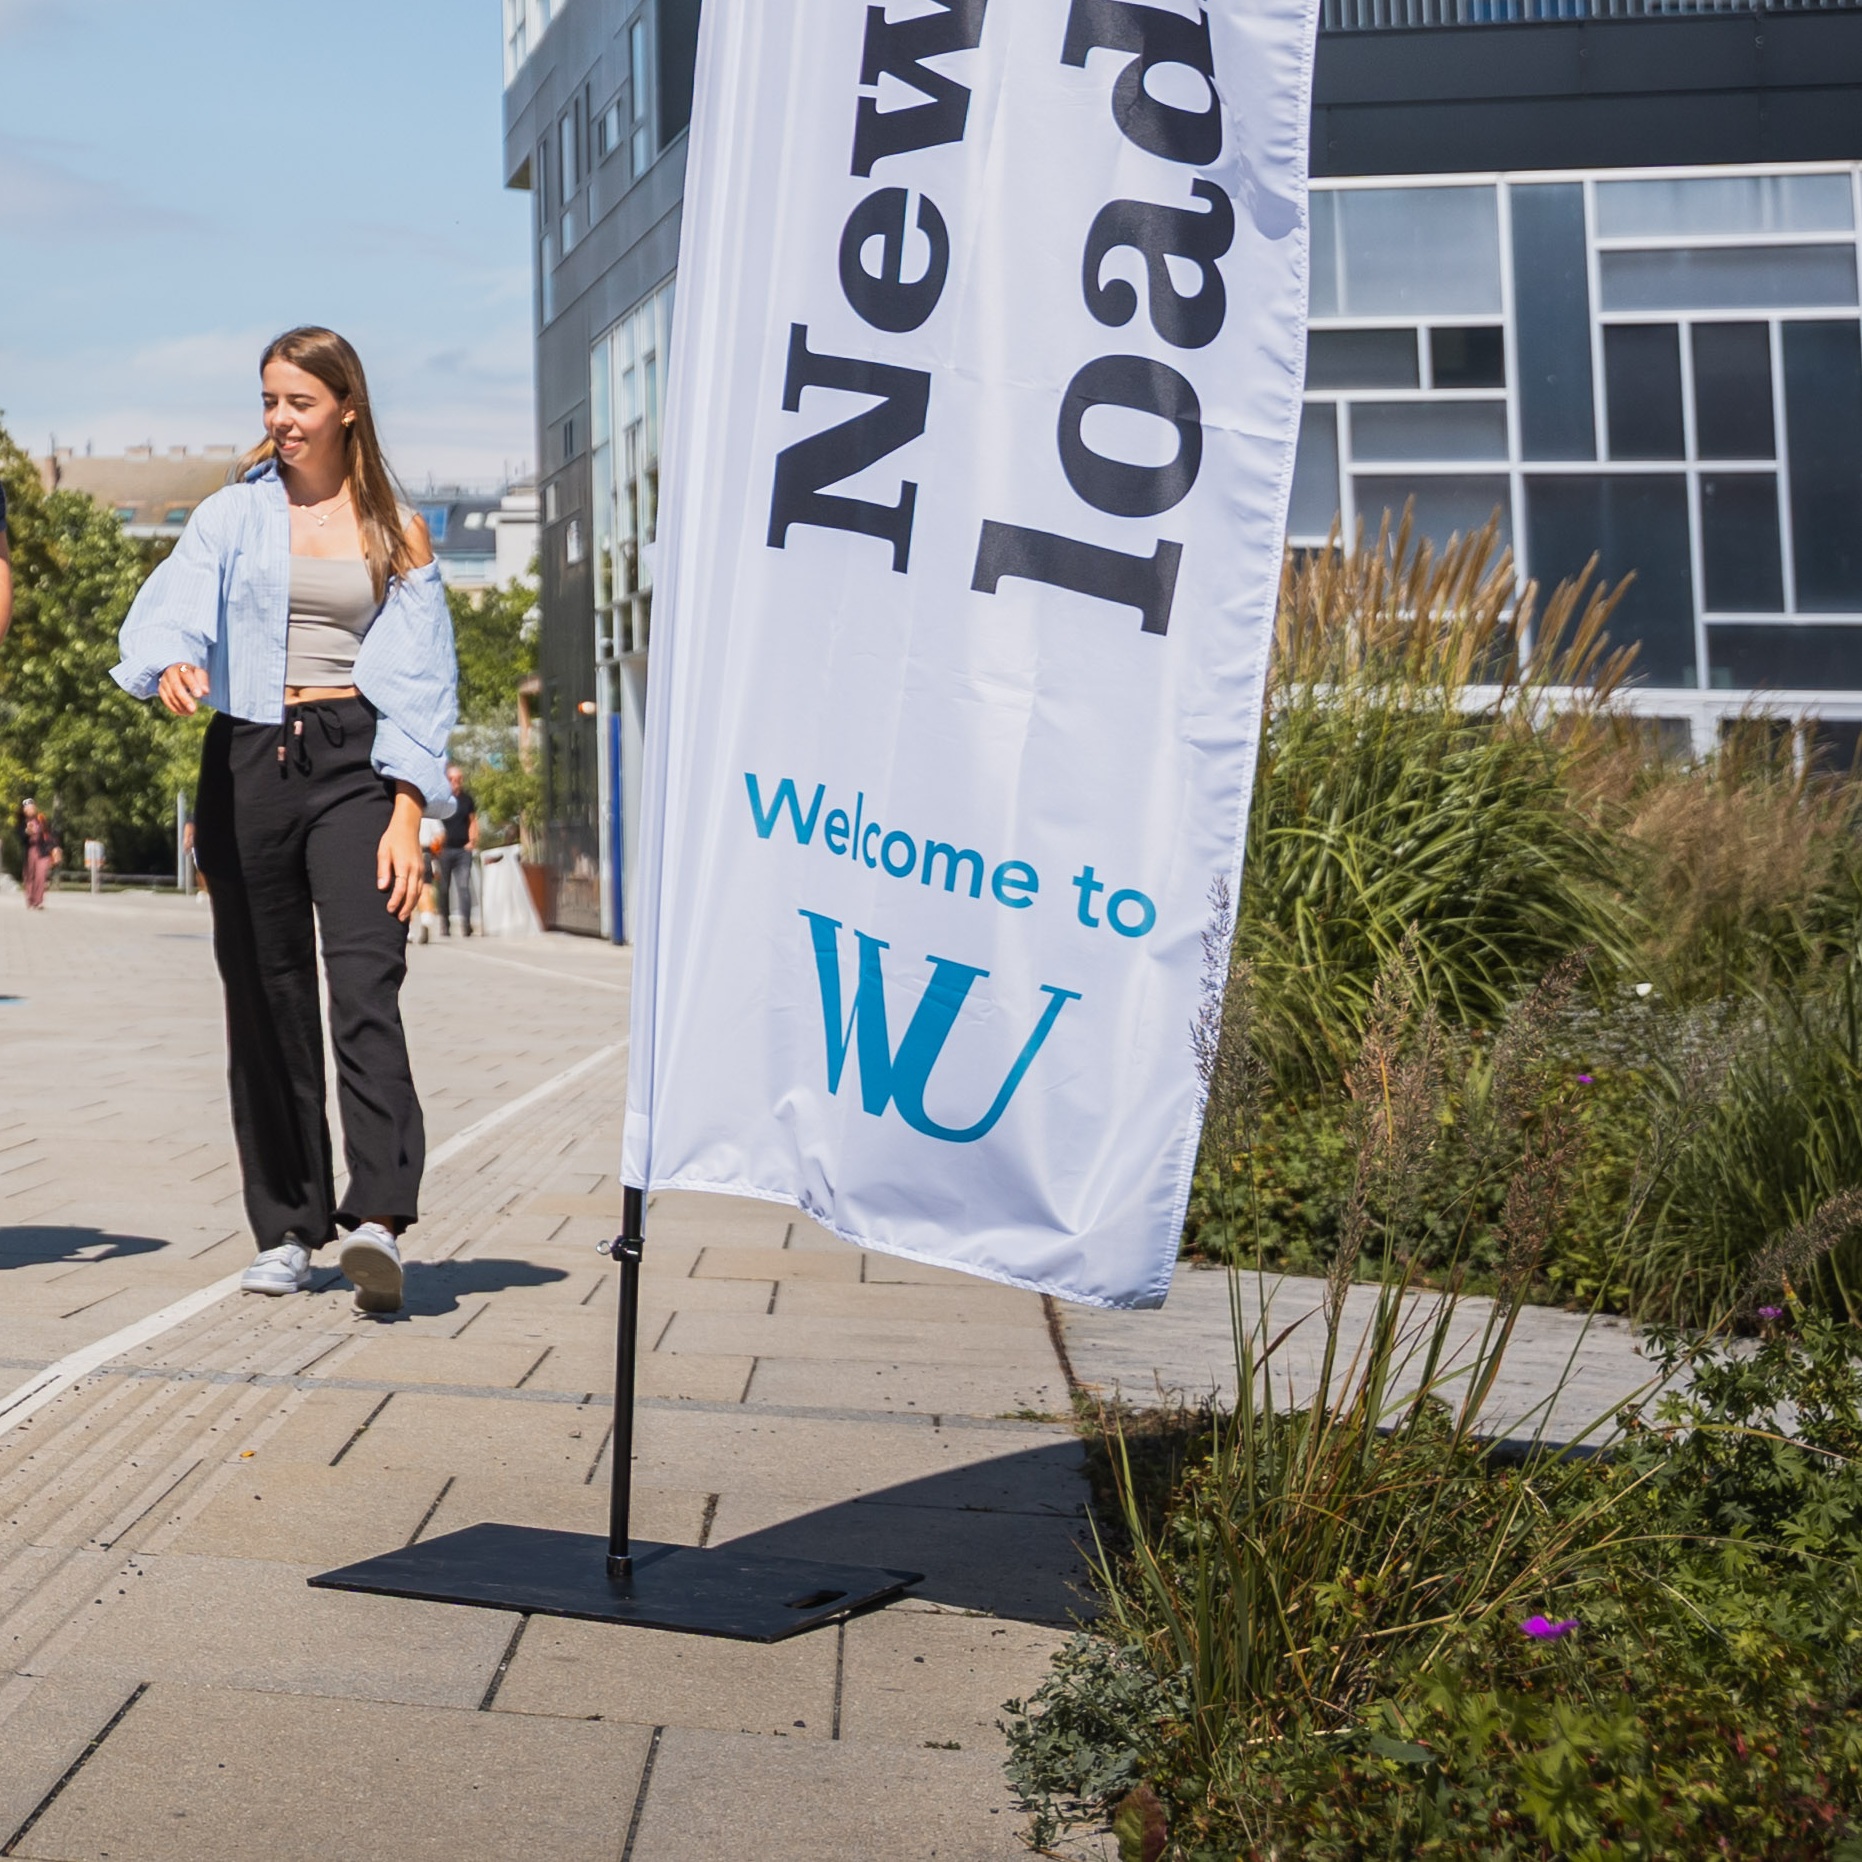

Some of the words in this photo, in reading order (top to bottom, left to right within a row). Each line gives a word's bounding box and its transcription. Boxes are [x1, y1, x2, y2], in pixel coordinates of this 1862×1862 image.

[743, 771, 1040, 909] Welcome
[1072, 865, 1157, 939] to
[797, 908, 1083, 1144] WU
